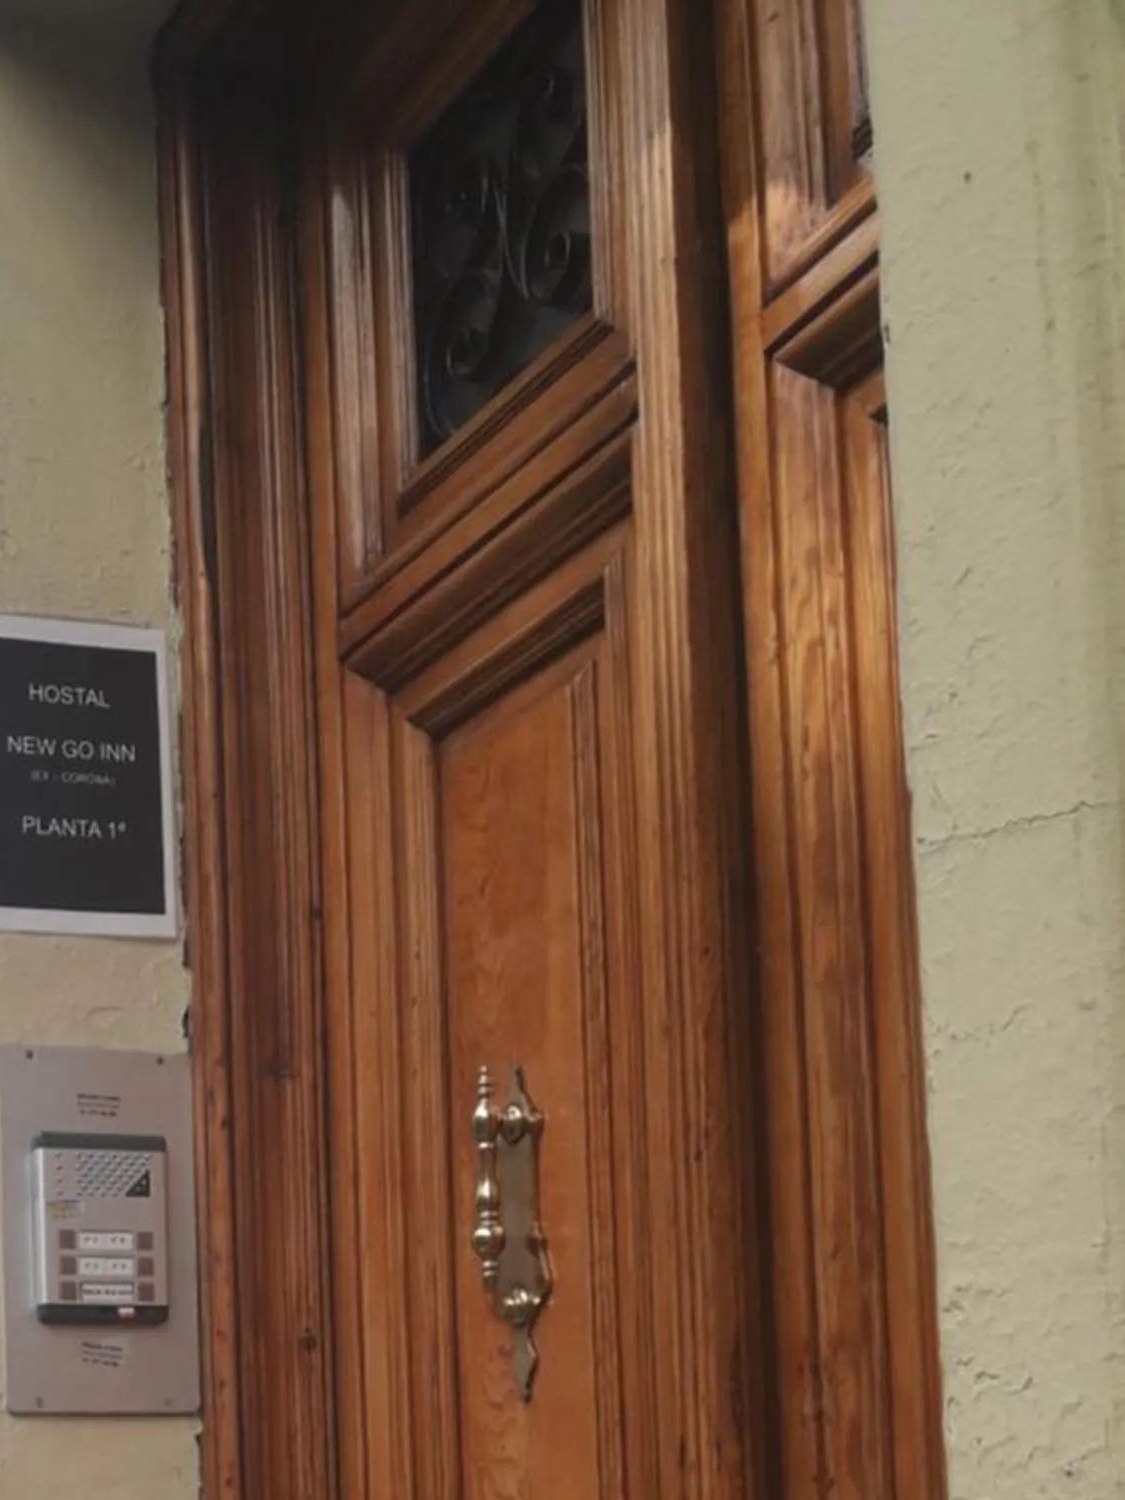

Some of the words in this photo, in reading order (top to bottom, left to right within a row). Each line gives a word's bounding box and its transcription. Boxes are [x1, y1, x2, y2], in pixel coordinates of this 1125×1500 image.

[29, 683, 110, 708] HOSTAL
[7, 735, 57, 756] NEW
[61, 740, 95, 760] GO
[100, 744, 136, 762] INN
[22, 815, 102, 838] PLANTA
